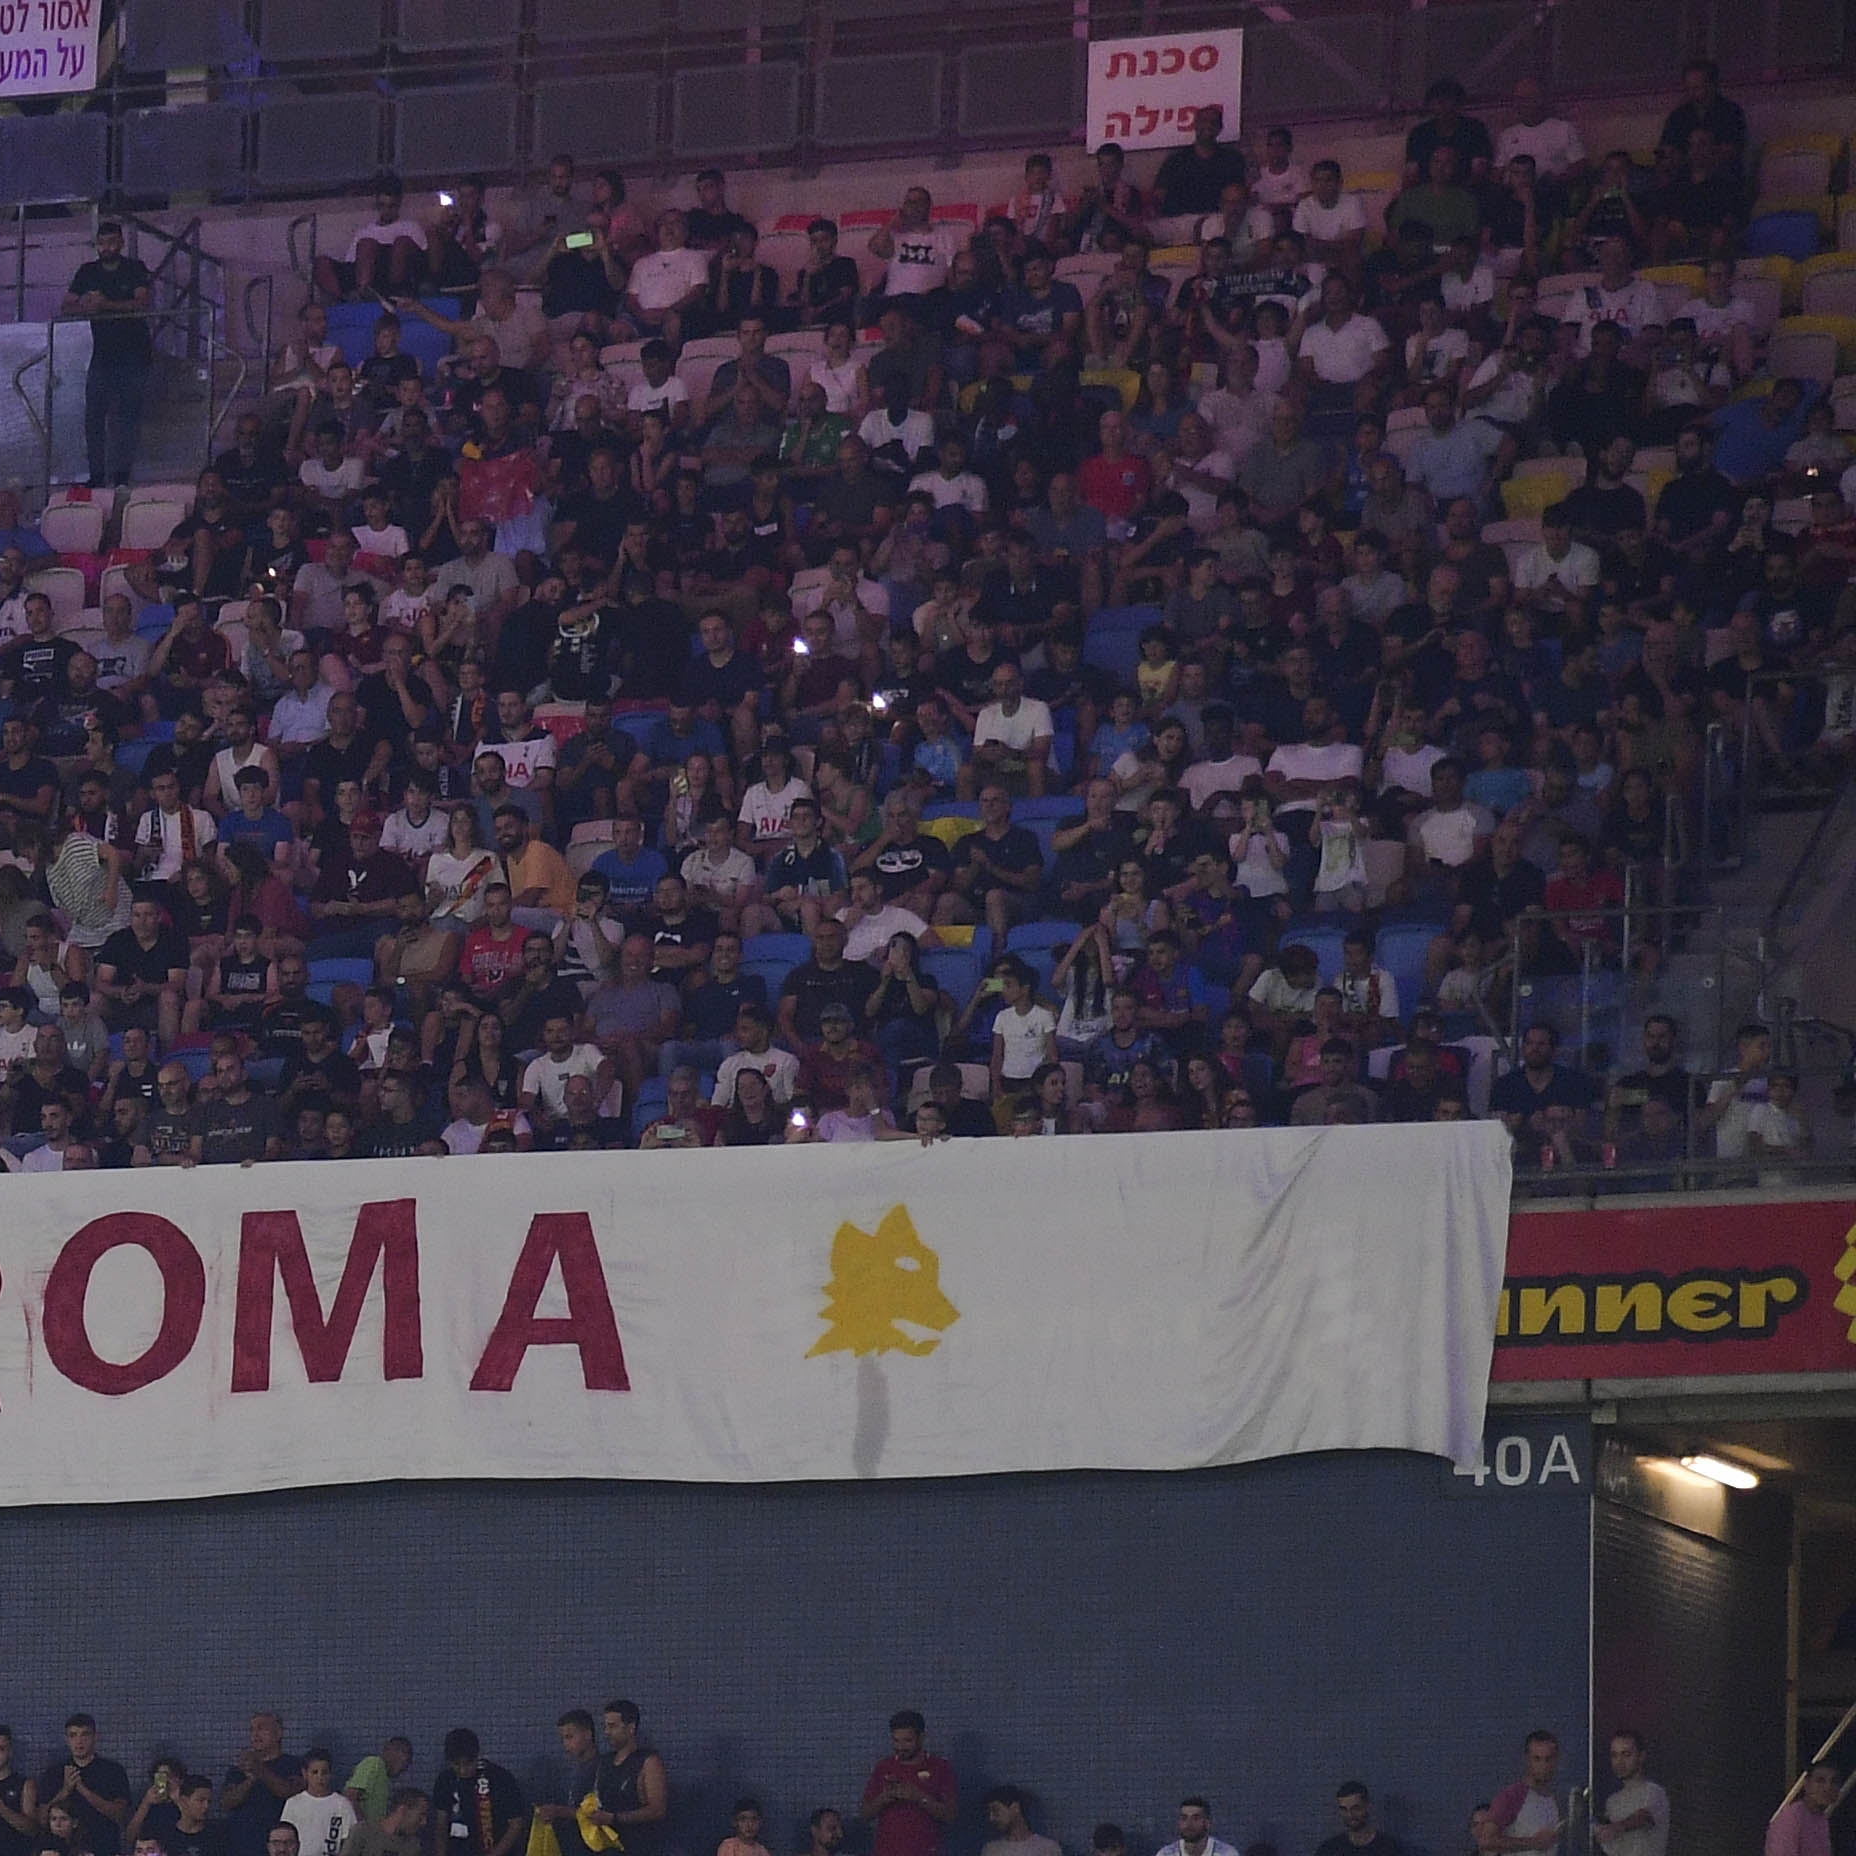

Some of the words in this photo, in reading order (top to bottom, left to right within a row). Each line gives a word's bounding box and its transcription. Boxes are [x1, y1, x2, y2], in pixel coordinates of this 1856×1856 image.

[39, 0, 89, 31] אסור
[56, 37, 85, 81] על
[1105, 44, 1220, 80] סכנת
[1104, 103, 1225, 139] פילה
[1495, 1274, 1797, 1338] inner
